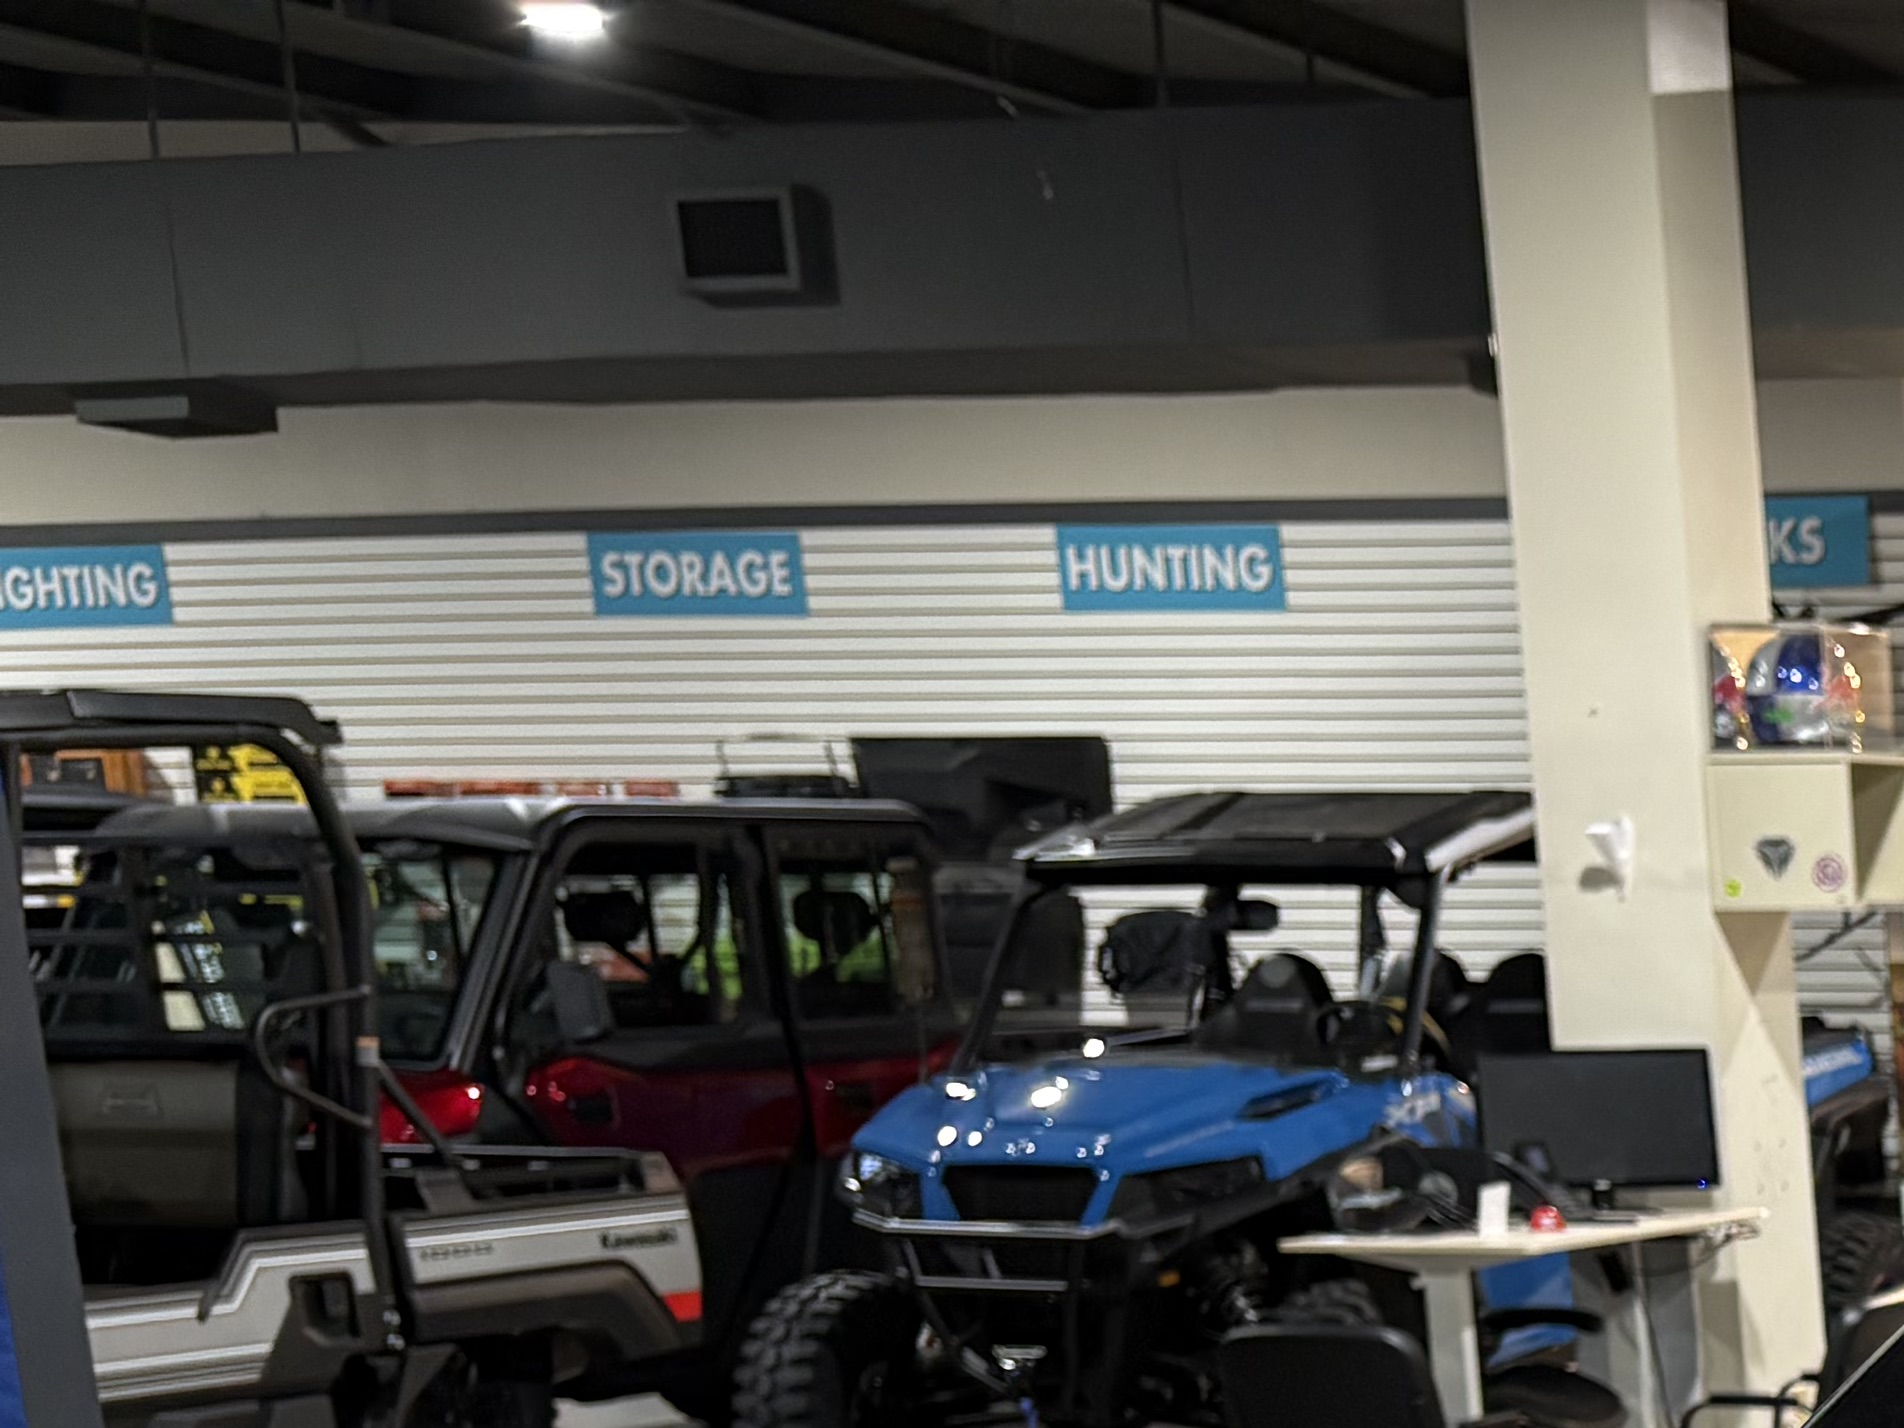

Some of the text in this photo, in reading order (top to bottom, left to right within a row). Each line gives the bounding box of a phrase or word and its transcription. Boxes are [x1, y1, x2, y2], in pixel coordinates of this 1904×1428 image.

[0, 563, 158, 611] GHTING
[601, 550, 794, 598] STORAGE
[1066, 543, 1273, 592] HUNTING
